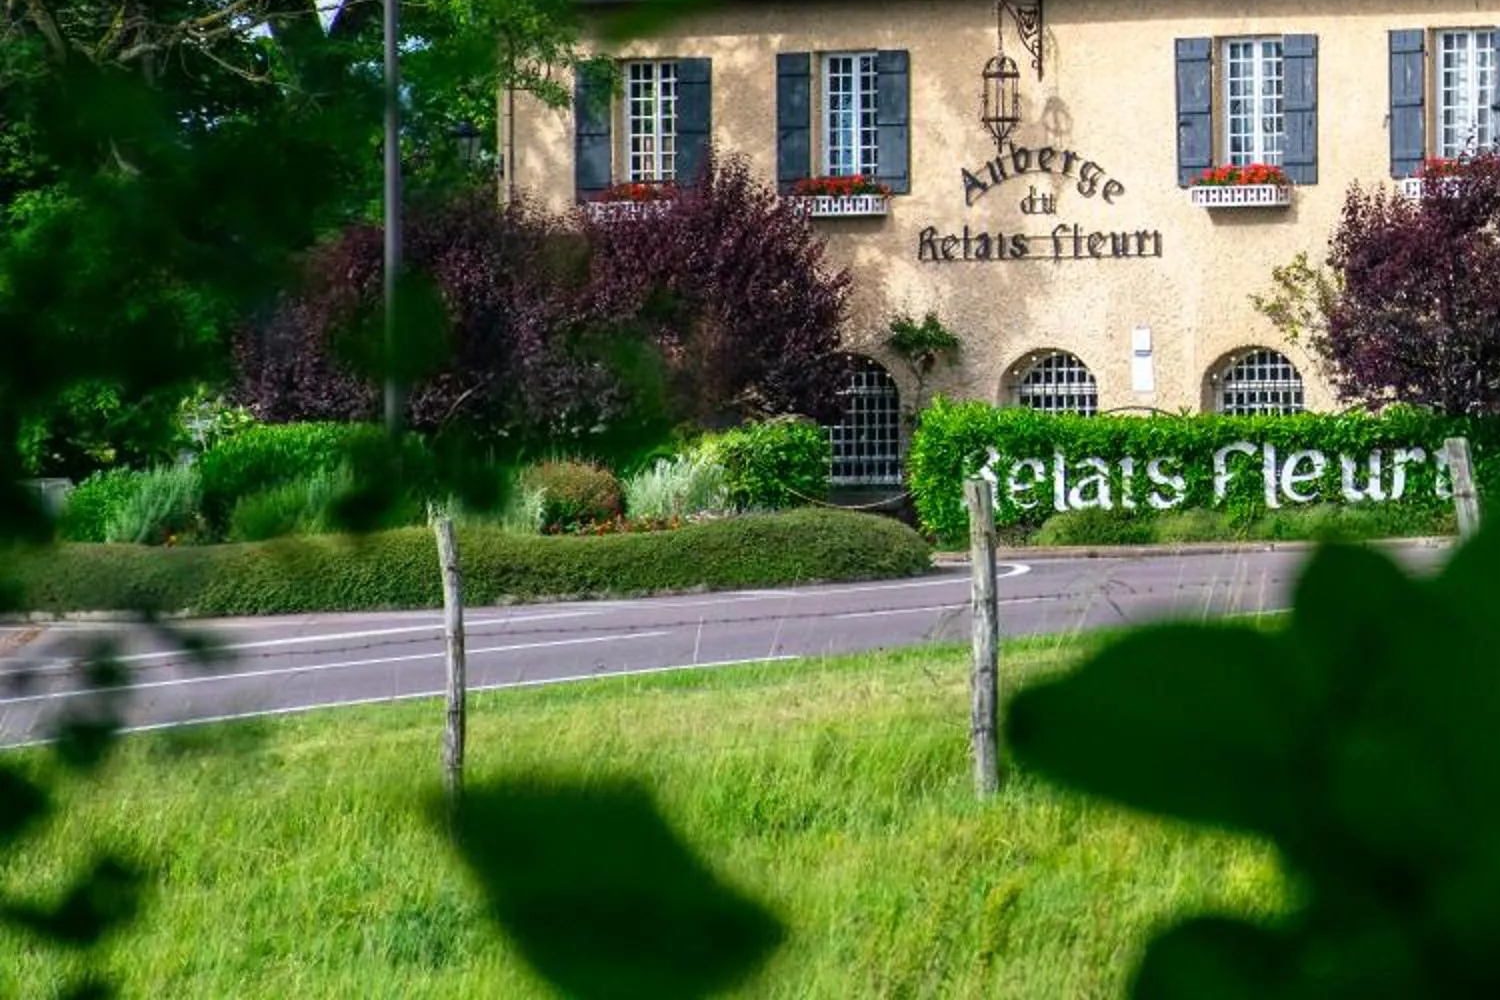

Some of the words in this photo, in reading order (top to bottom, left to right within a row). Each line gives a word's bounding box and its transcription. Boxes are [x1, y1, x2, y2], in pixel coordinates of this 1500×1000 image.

[961, 141, 1125, 206] Auberge
[1020, 185, 1057, 215] du
[918, 224, 1029, 262] Relais
